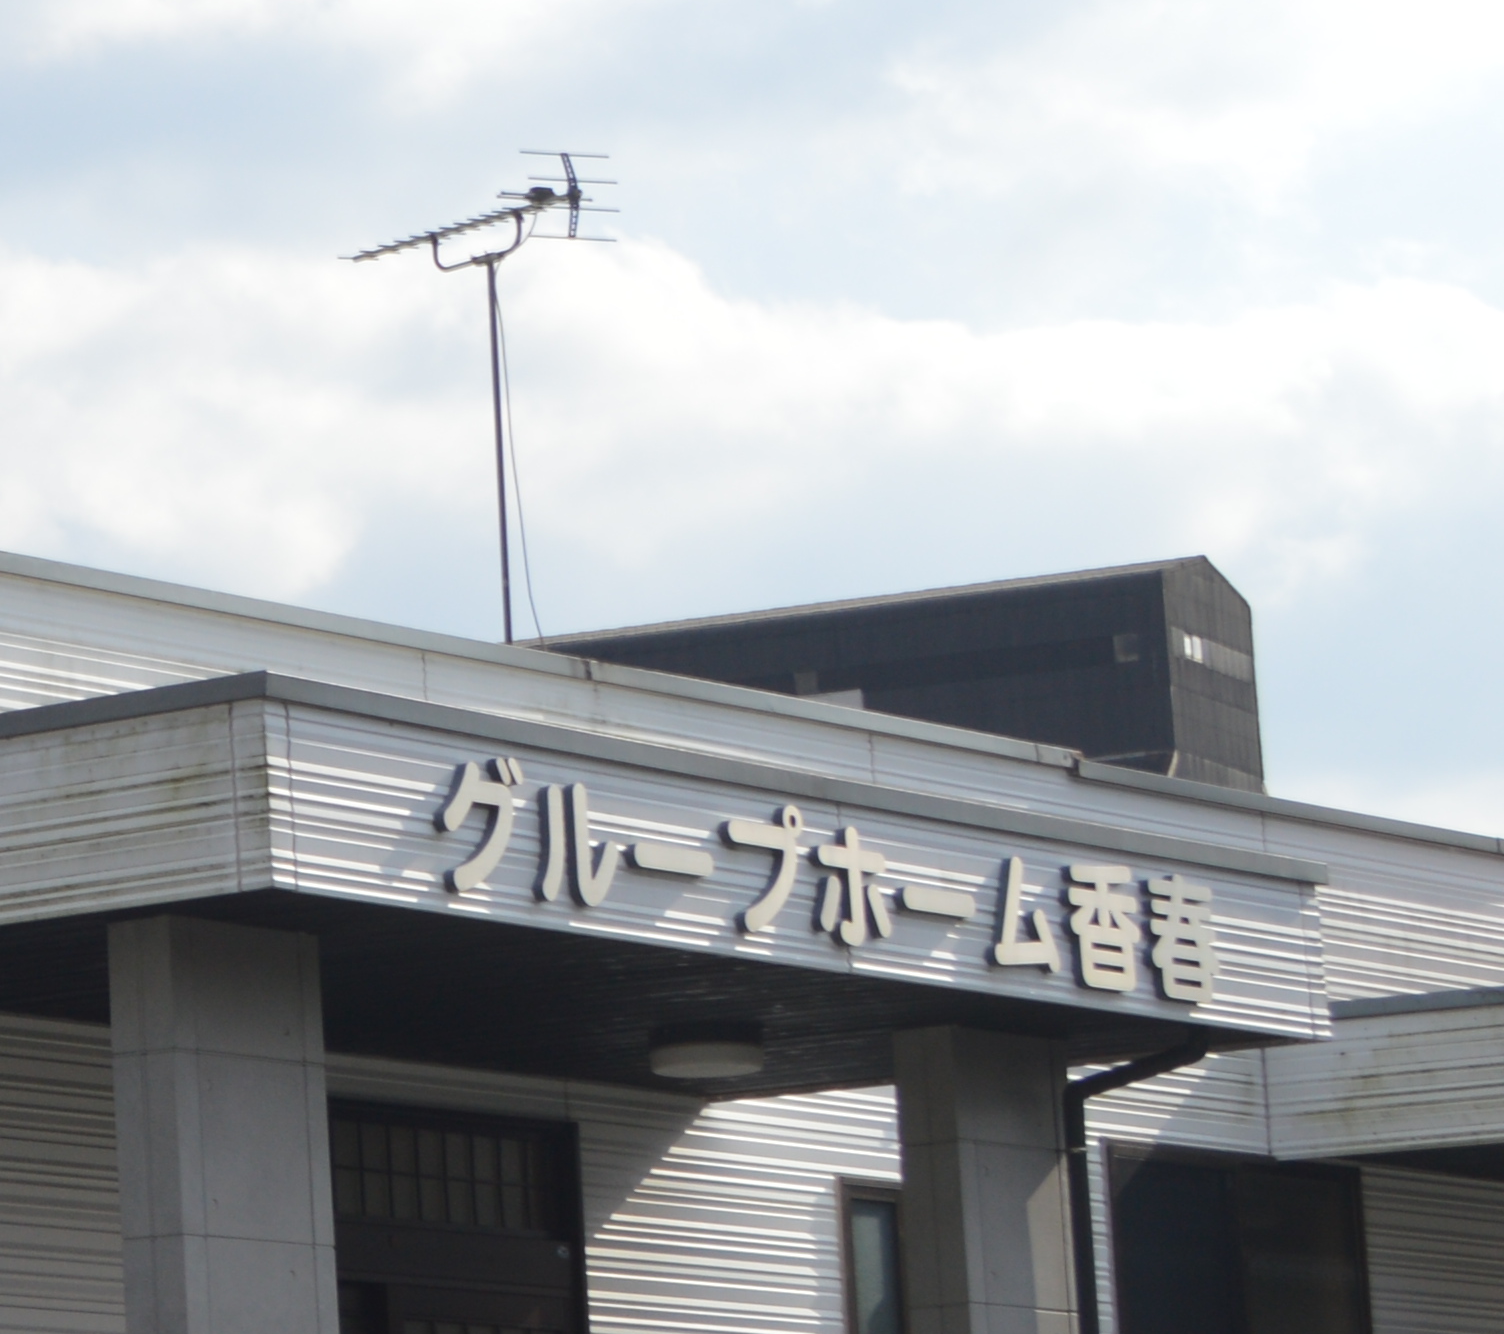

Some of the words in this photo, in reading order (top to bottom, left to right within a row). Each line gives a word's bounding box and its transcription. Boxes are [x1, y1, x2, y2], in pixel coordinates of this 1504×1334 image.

[436, 758, 1218, 1004] グループホーム香春
